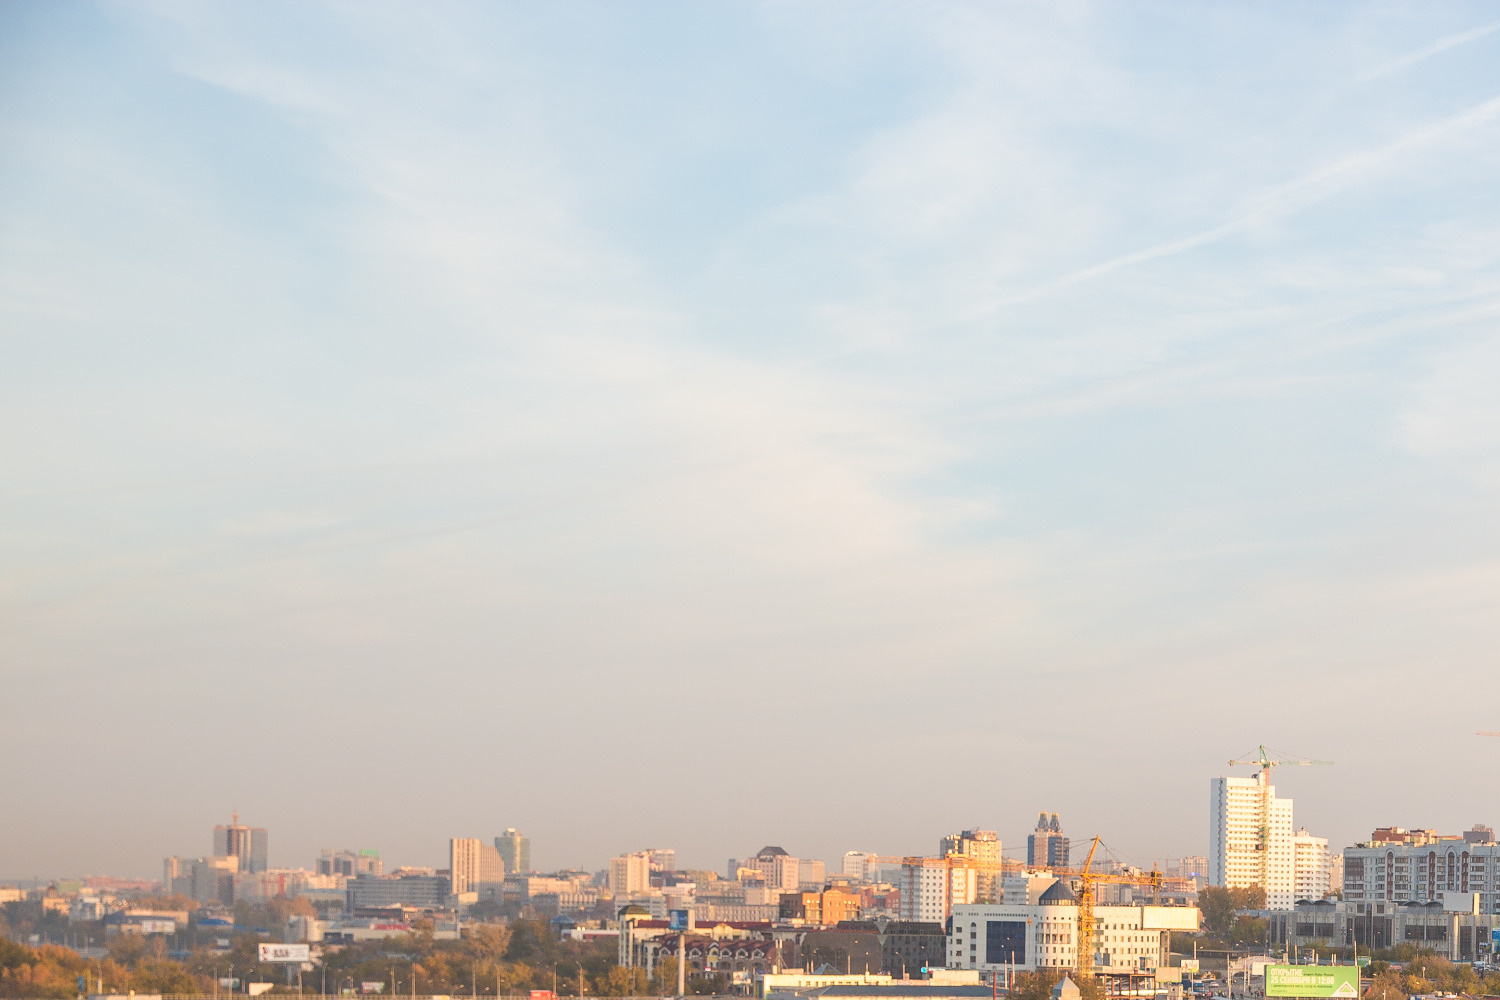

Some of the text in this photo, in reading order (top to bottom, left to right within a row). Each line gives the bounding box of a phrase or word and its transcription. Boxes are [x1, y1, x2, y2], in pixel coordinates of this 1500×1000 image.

[1271, 968, 1303, 976] ОТКРЫТИЕ
[1271, 976, 1279, 984] 25
[1280, 976, 1310, 984] СЕНТЯБРЯ
[1317, 976, 1335, 985] 12:00
